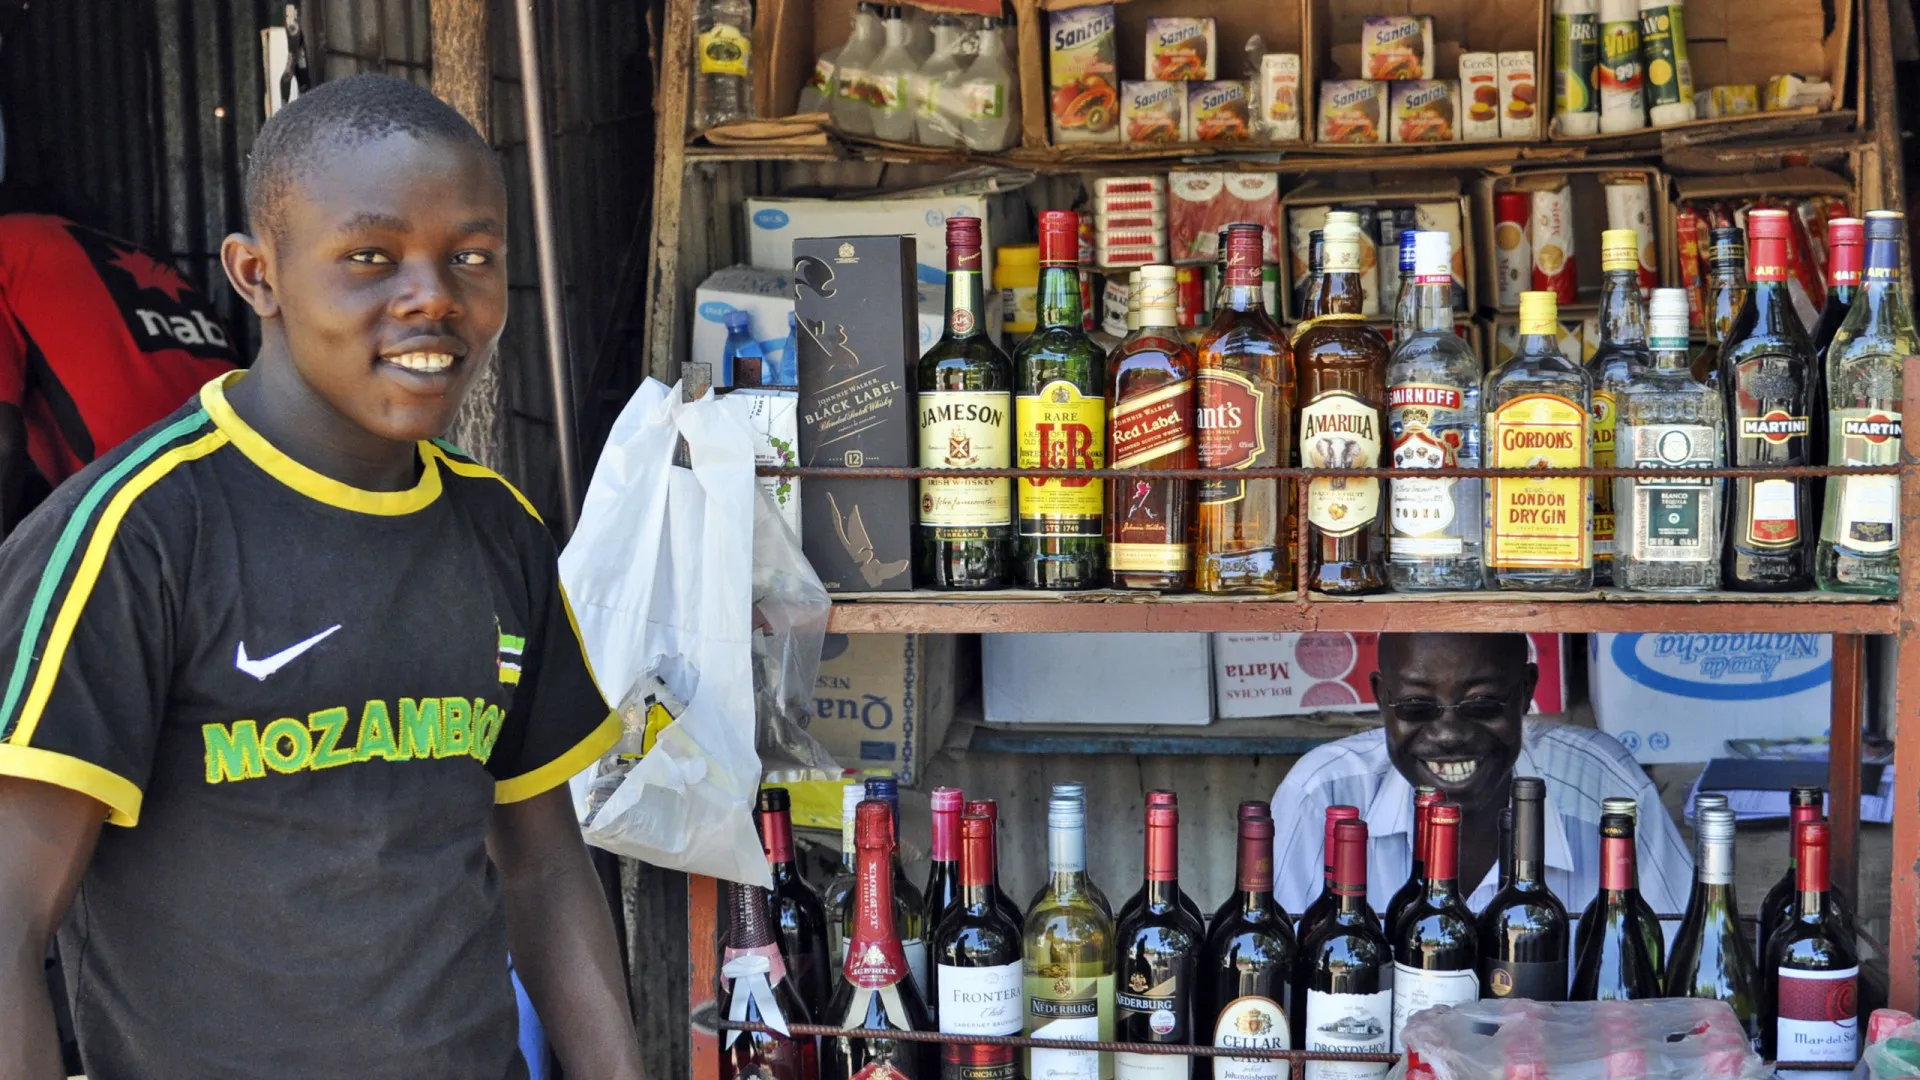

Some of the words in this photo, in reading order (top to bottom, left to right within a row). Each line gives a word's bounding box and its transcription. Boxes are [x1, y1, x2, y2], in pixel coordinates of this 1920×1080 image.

[1603, 29, 1639, 57] Vim
[804, 399, 850, 425] BLACK
[855, 380, 901, 405] LABEL
[1390, 389, 1455, 406] SMIRNOFF
[921, 403, 1003, 429] JAMESON
[1044, 412, 1078, 422] RARE
[1113, 426, 1141, 444] Red
[1141, 411, 1182, 435] Label
[1305, 414, 1374, 441] AMARULA
[1745, 421, 1806, 433] MARTINI
[1503, 429, 1574, 451] GORDON'S
[847, 453, 860, 465] 12
[1511, 493, 1565, 506] LONDON
[1509, 509, 1539, 524] DRY
[1541, 510, 1566, 525] GIN
[1225, 662, 1291, 683] Maria
[1226, 687, 1293, 699] BOLACHAS
[1032, 1000, 1096, 1014] NEDERBURG
[1115, 992, 1172, 1010] NEDERBURG
[1223, 1034, 1281, 1049] CELLAR
[1794, 1032, 1824, 1045] Mar
[1827, 1035, 1842, 1045] del
